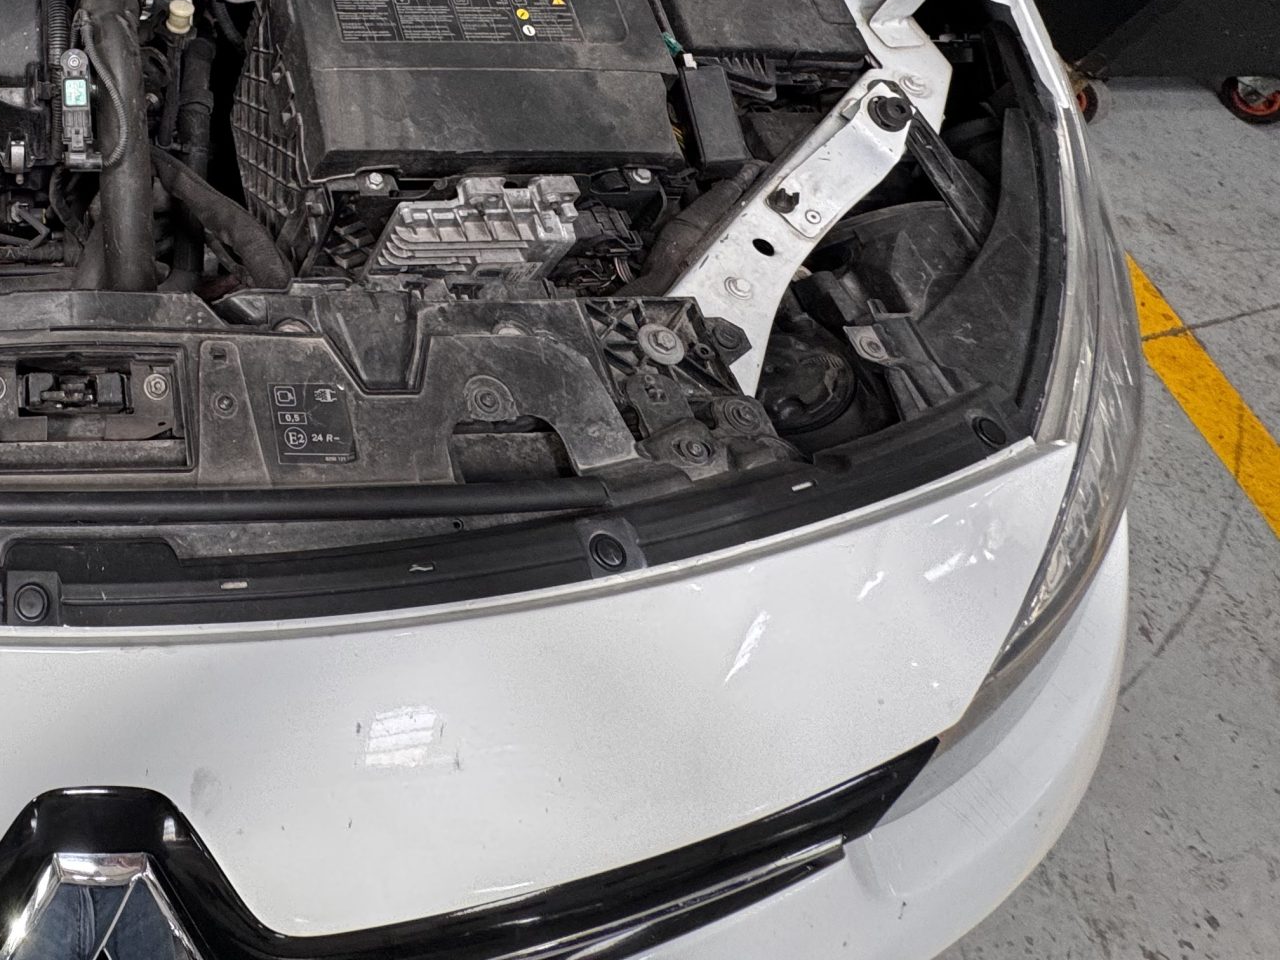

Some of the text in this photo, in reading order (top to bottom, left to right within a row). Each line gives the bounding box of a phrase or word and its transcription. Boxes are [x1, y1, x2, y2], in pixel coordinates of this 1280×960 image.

[285, 414, 300, 423] 0,5
[288, 432, 305, 445] E2
[311, 434, 323, 442] 24
